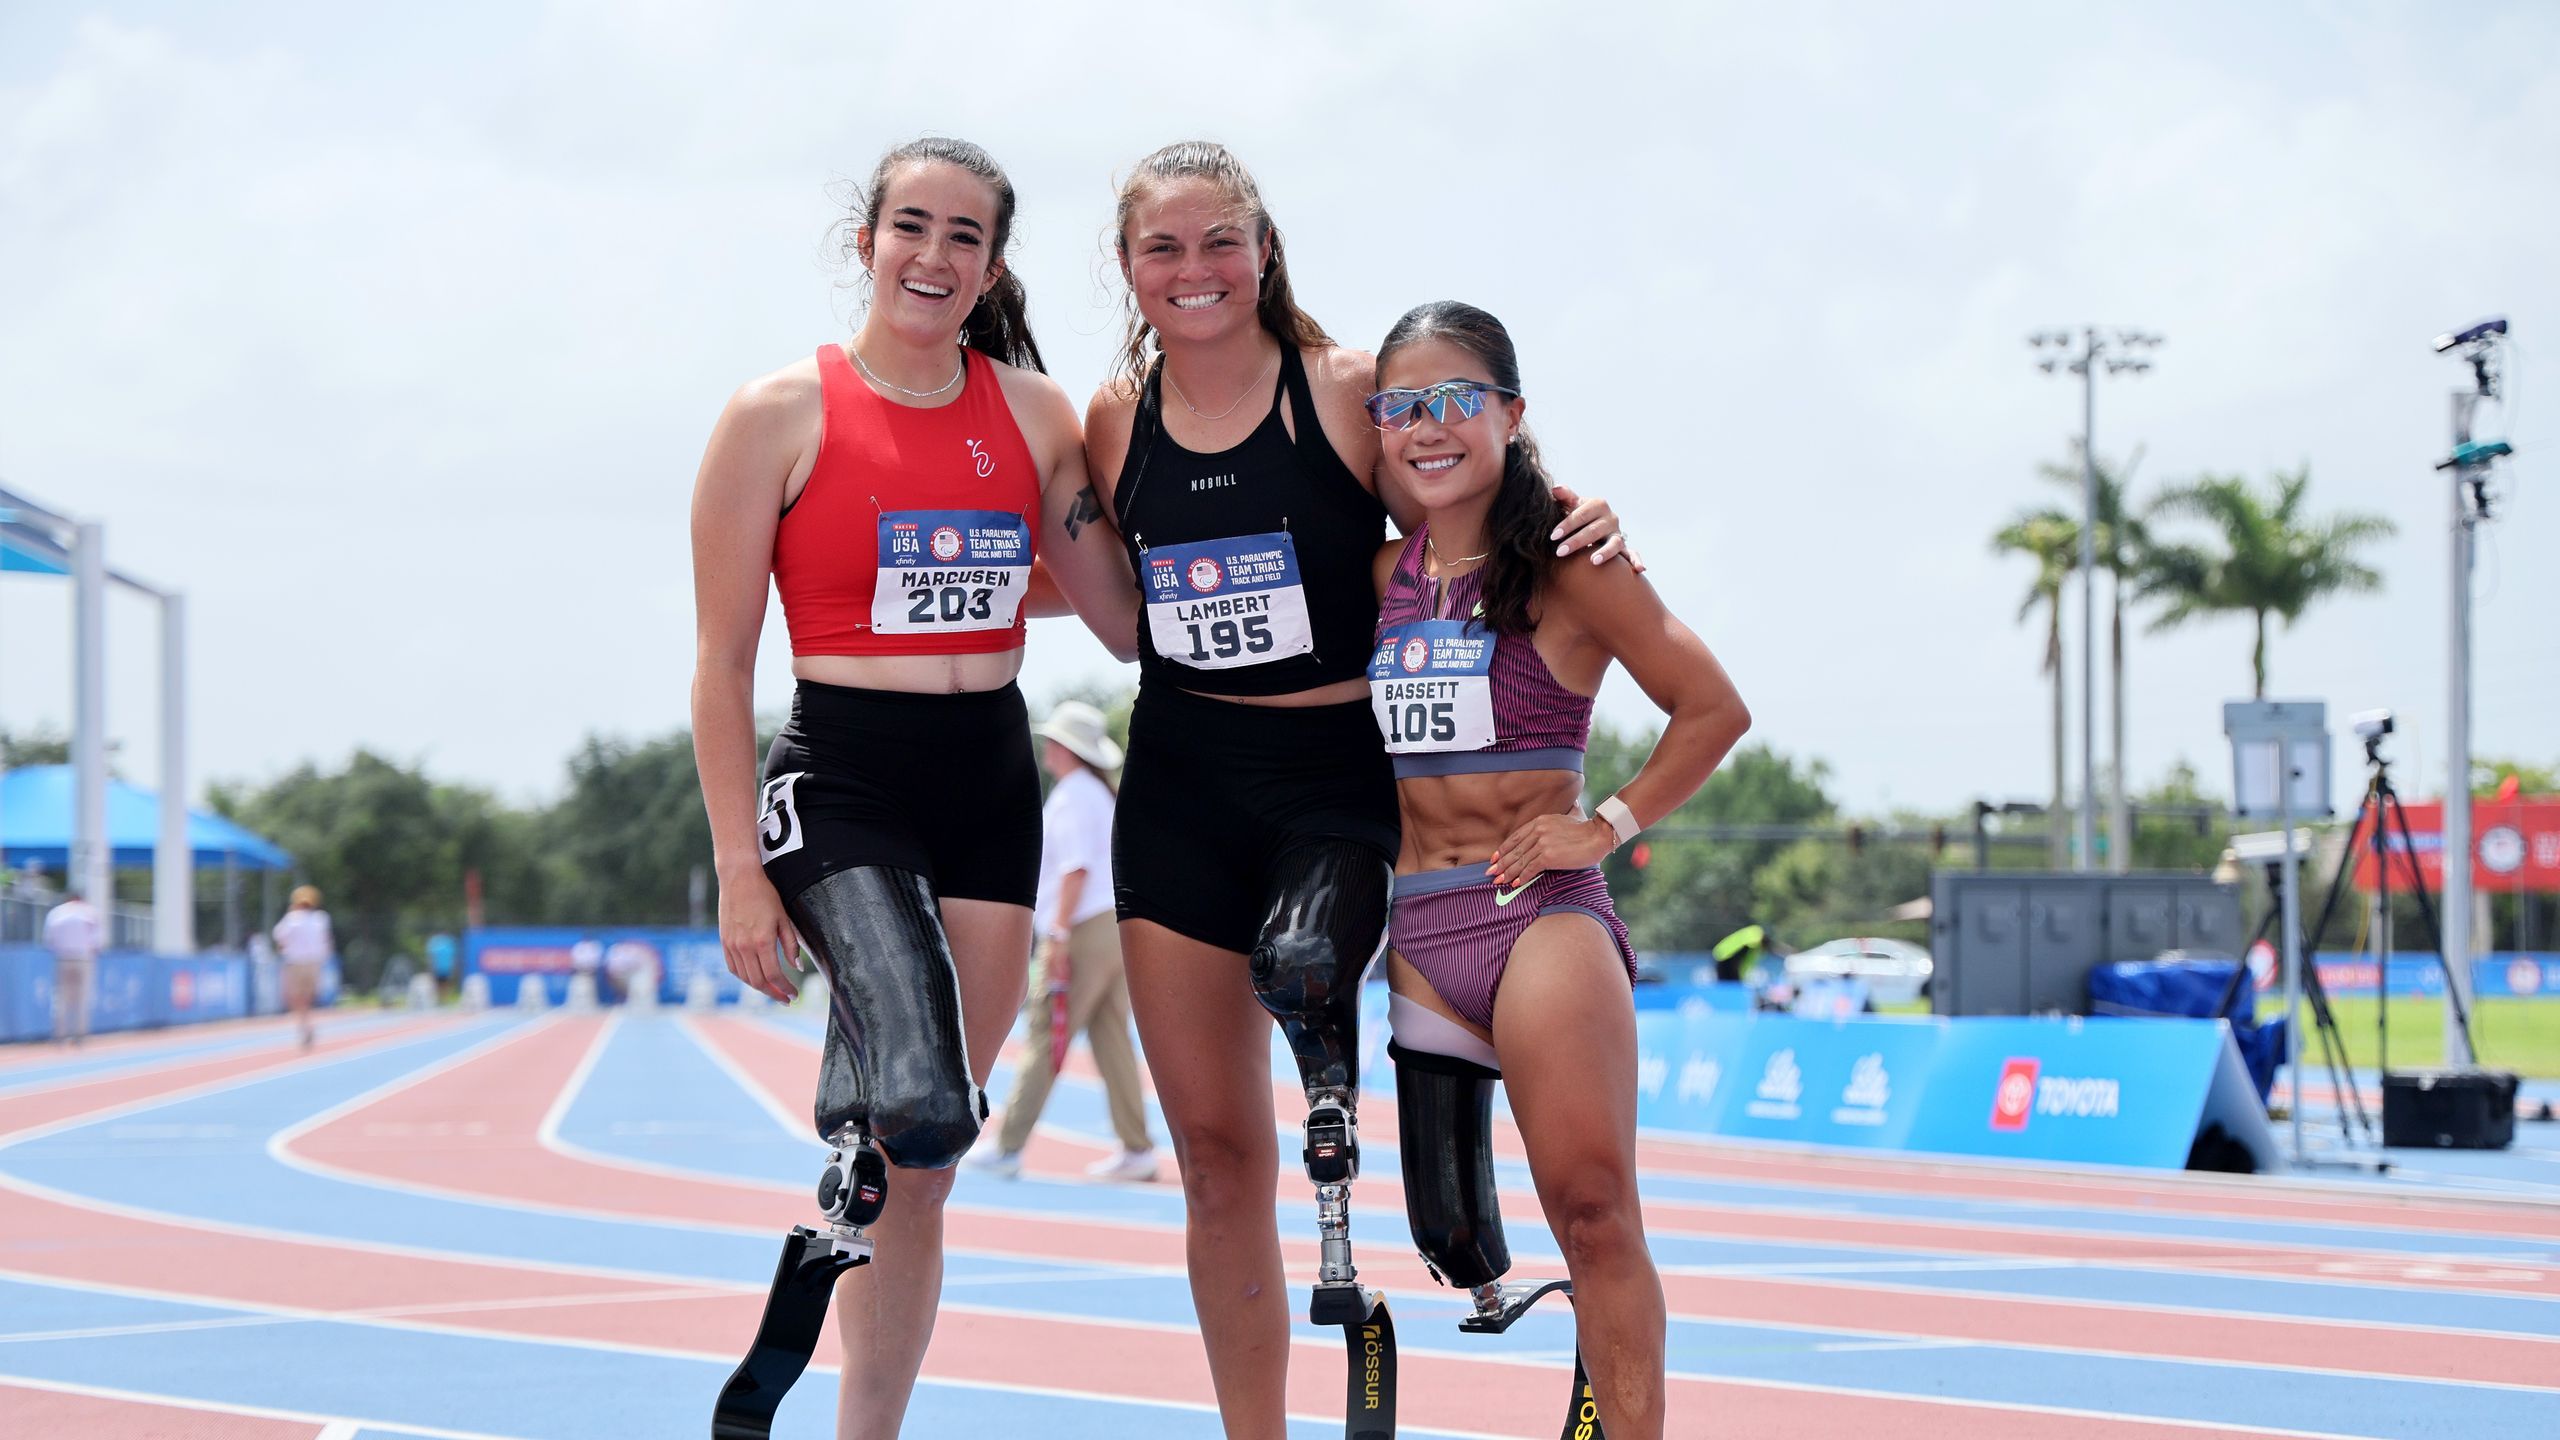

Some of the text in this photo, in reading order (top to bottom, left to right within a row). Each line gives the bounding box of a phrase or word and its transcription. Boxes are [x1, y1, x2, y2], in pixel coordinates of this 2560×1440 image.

[1191, 473, 1237, 492] NOBULL
[969, 528, 1018, 538] U.S. PARALYMPIC
[893, 537, 920, 553] USA
[969, 538, 1021, 549] TEAM TRIALS
[895, 557, 917, 566] xfinity
[971, 550, 1017, 558] TRACK AND FIELD
[1225, 550, 1283, 565] U.S. PARALYMPIC
[1154, 566, 1173, 574] TEAM
[1228, 560, 1286, 577] TEAM TRIALS
[901, 570, 1011, 587] MARCUSEN
[1153, 573, 1179, 589] USA
[1231, 572, 1281, 586] TRACK AND FIELD
[907, 587, 994, 623] 203
[1159, 593, 1178, 602] xfinity
[1176, 594, 1271, 622] LAMBERT
[1186, 614, 1274, 661] 195
[1433, 639, 1445, 648] U.S.
[1446, 639, 1485, 648] PARALYMPIC
[1375, 650, 1395, 665] USA
[1432, 649, 1482, 660] TEAM TRIALS
[1432, 661, 1448, 669] TRACK
[1385, 681, 1459, 701] BASSETT
[1388, 702, 1456, 743] 105
[2036, 1076, 2120, 1118] TOYOTA
[1365, 1340, 1383, 1409] ÖSSUR
